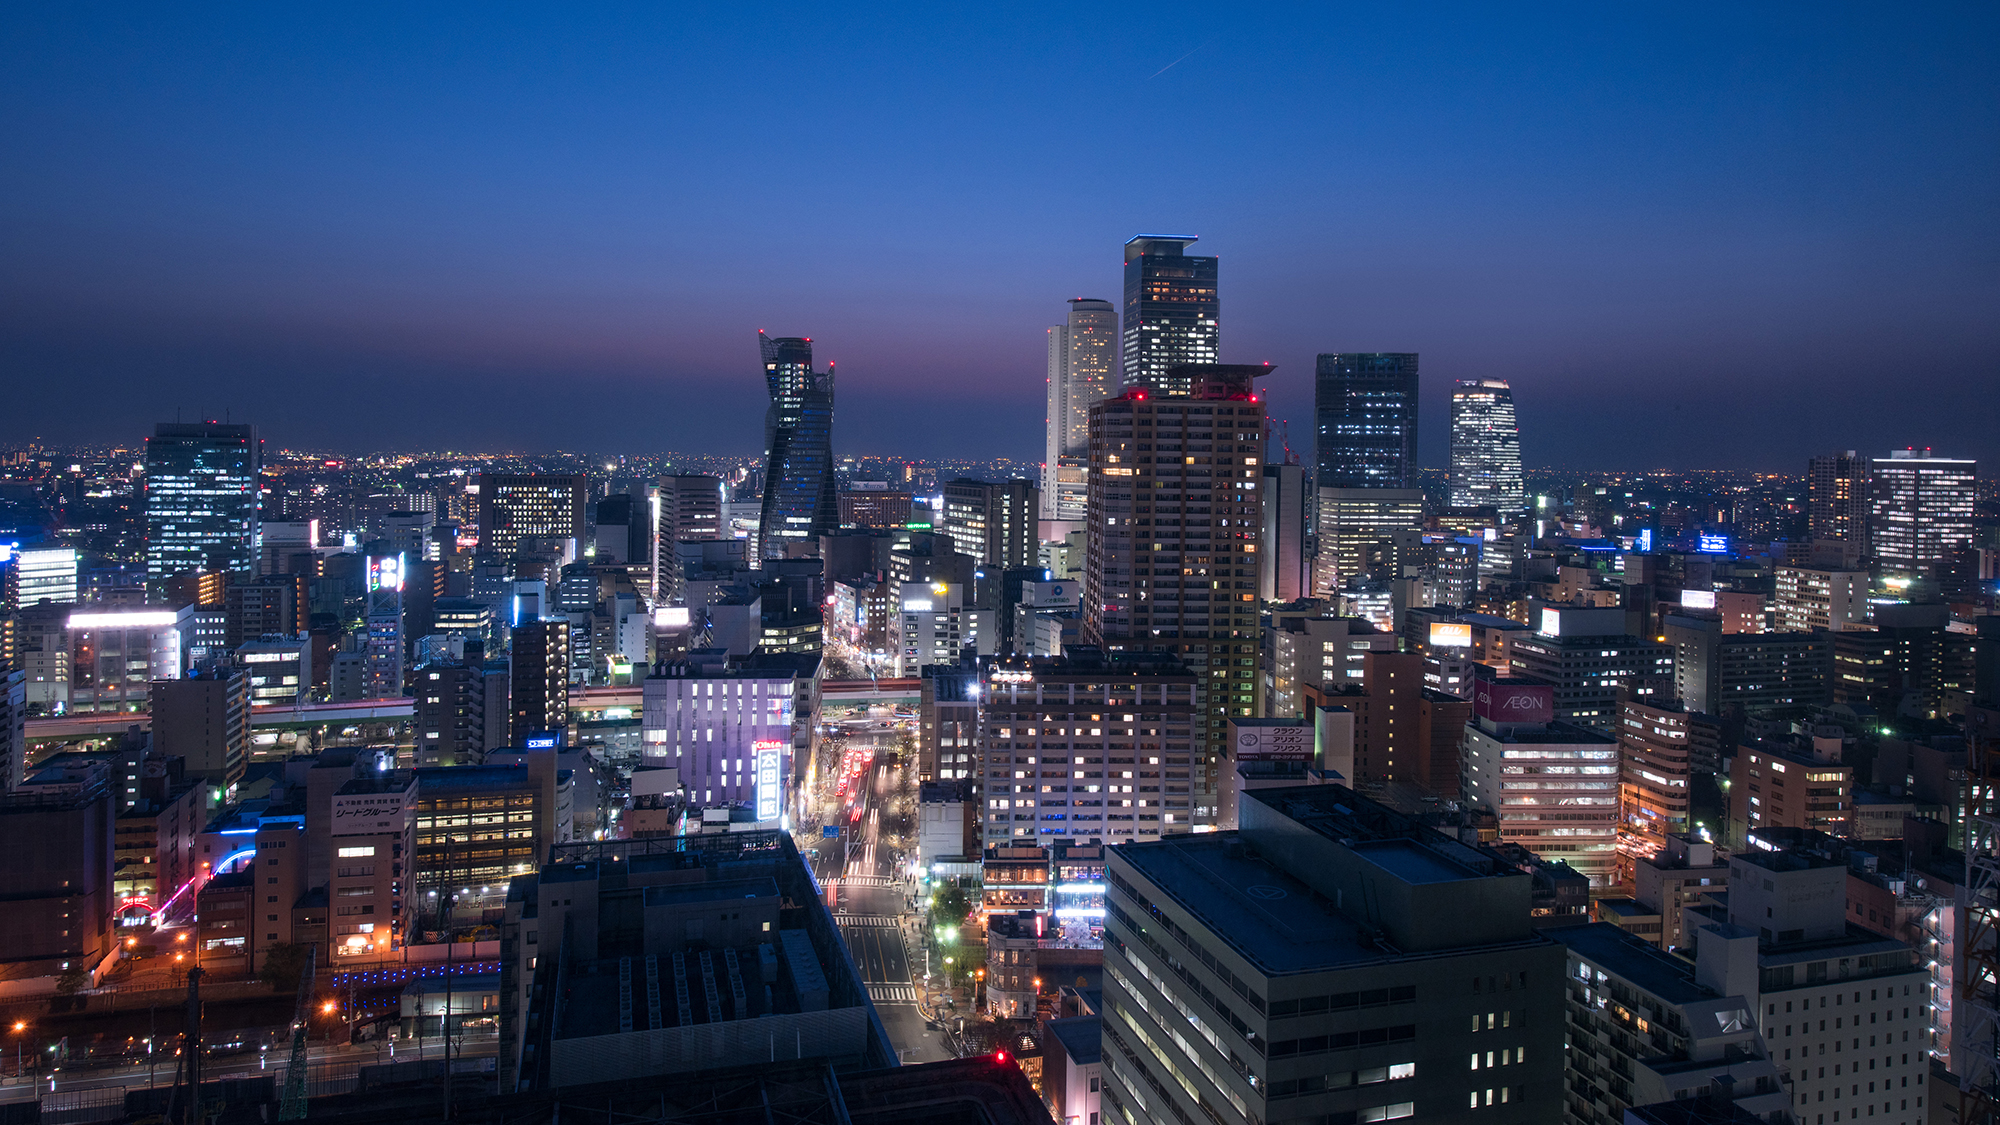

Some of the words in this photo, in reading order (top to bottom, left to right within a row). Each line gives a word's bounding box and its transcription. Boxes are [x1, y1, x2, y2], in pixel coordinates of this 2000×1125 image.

[371, 563, 380, 591] グループ
[1439, 626, 1463, 635] au
[757, 741, 782, 750] Ohta
[336, 807, 400, 818] リードグループ
